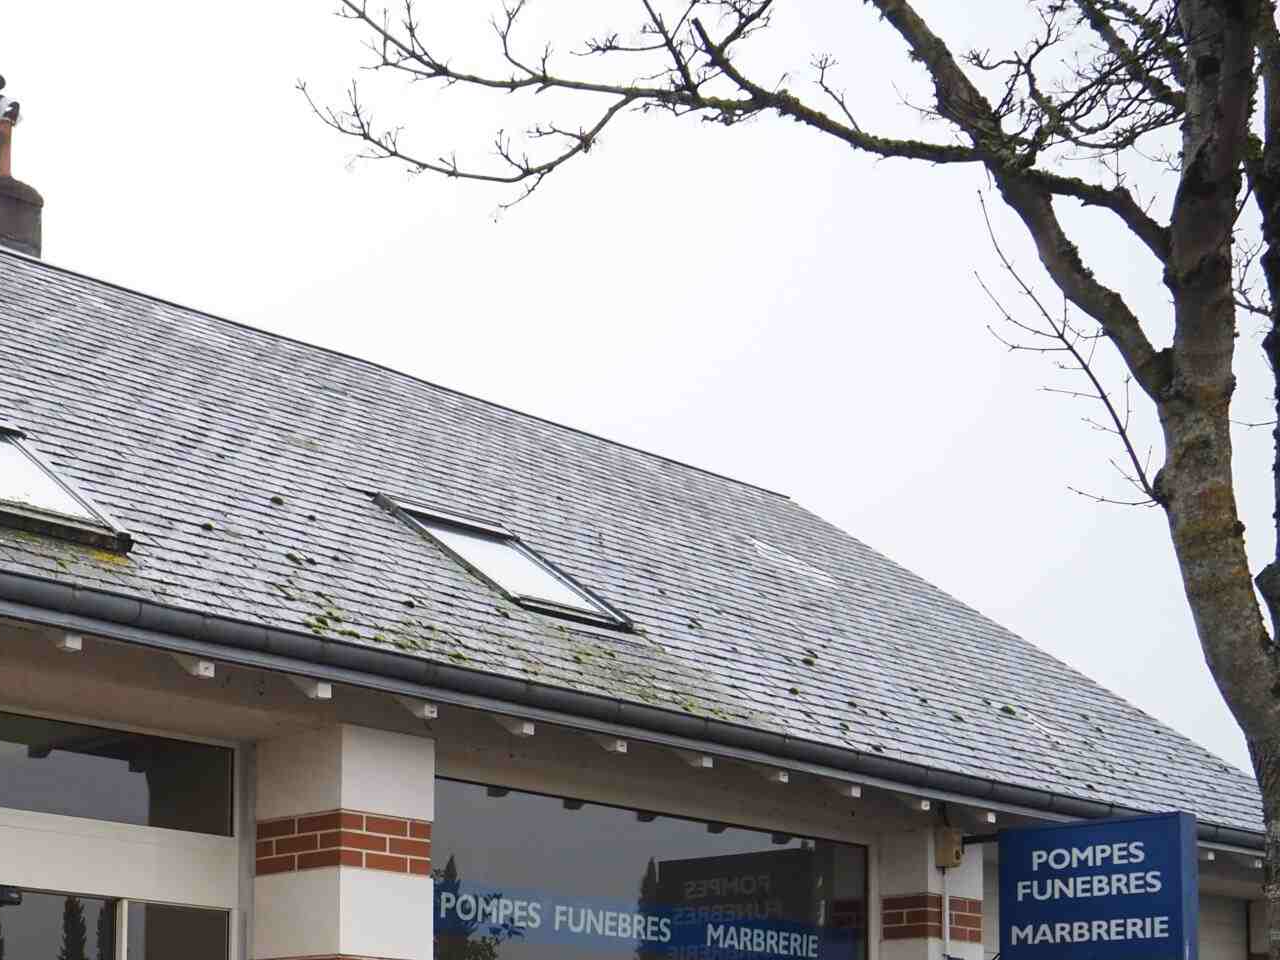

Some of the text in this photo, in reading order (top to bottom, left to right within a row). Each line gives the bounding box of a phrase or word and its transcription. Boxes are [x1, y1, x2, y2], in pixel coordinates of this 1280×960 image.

[1031, 841, 1145, 871] POMPES
[1017, 871, 1162, 901] FUNEBRES
[439, 891, 542, 929] POMPES
[554, 905, 671, 942] FUNEBRES
[706, 923, 819, 959] MARBRERIE
[1011, 916, 1169, 945] MARBRERIE
